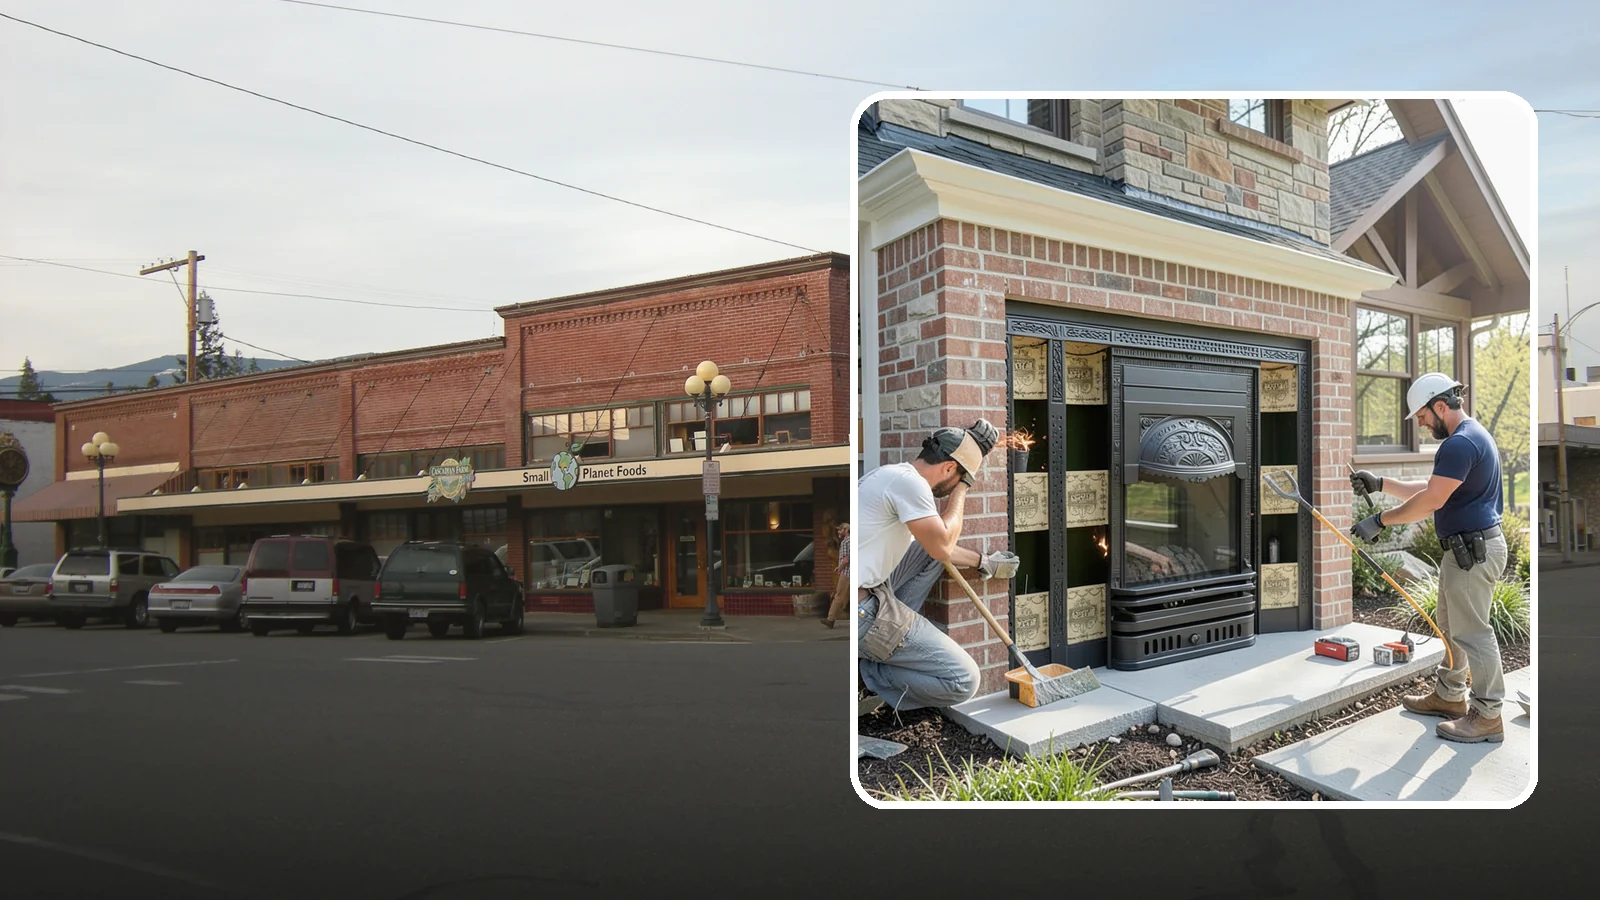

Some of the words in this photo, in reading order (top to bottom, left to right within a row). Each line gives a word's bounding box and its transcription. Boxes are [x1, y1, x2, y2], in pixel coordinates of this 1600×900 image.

[523, 471, 549, 483] Small
[583, 467, 614, 479] Planet
[617, 464, 647, 477] Foods
